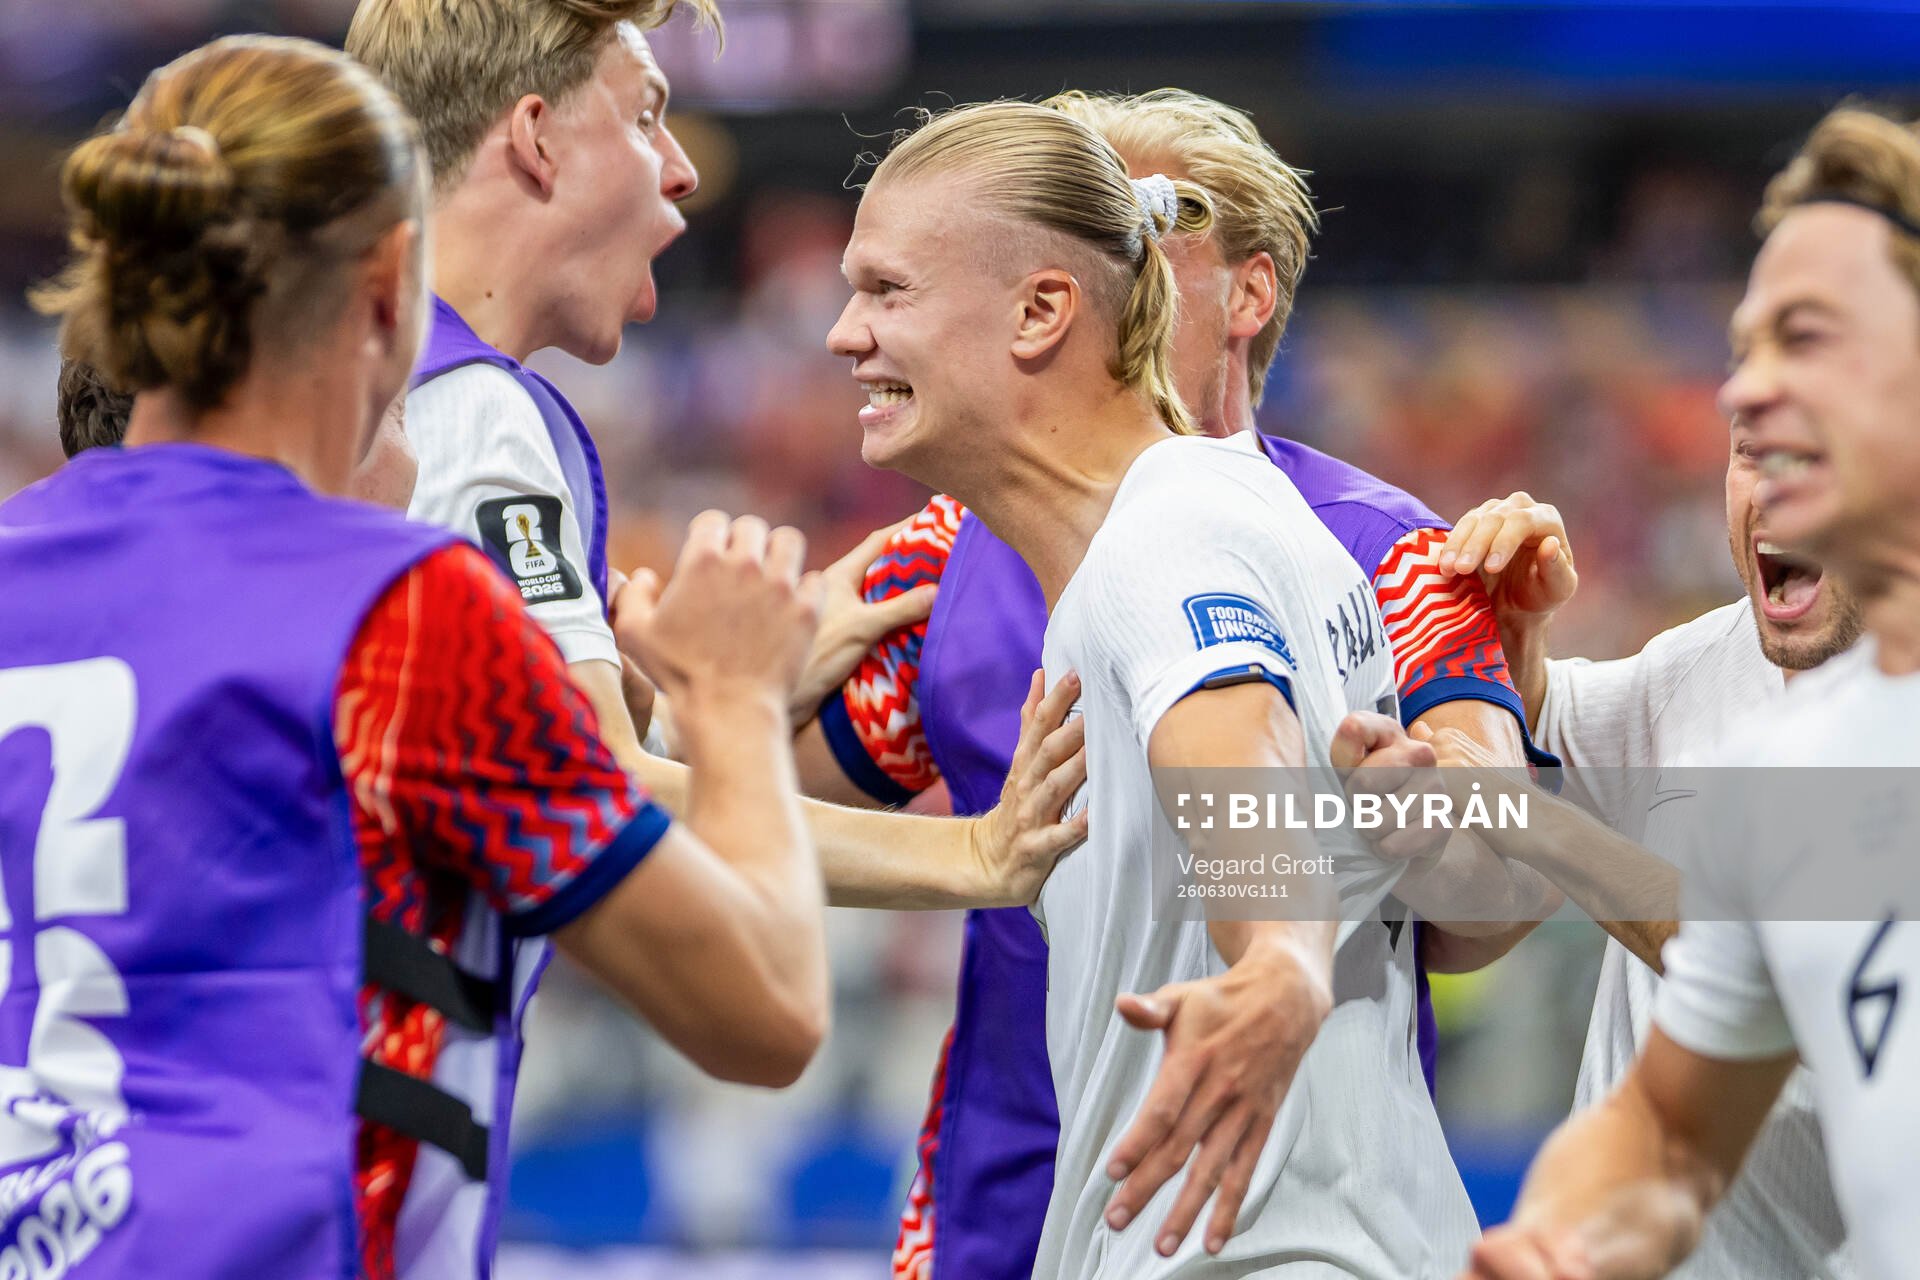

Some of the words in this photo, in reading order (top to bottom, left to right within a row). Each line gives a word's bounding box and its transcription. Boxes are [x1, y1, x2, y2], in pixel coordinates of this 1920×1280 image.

[525, 559, 545, 569] FIFA
[517, 576, 545, 587] WORLD
[545, 573, 561, 583] CUP
[520, 581, 565, 600] 2026
[1846, 908, 1903, 1080] 6
